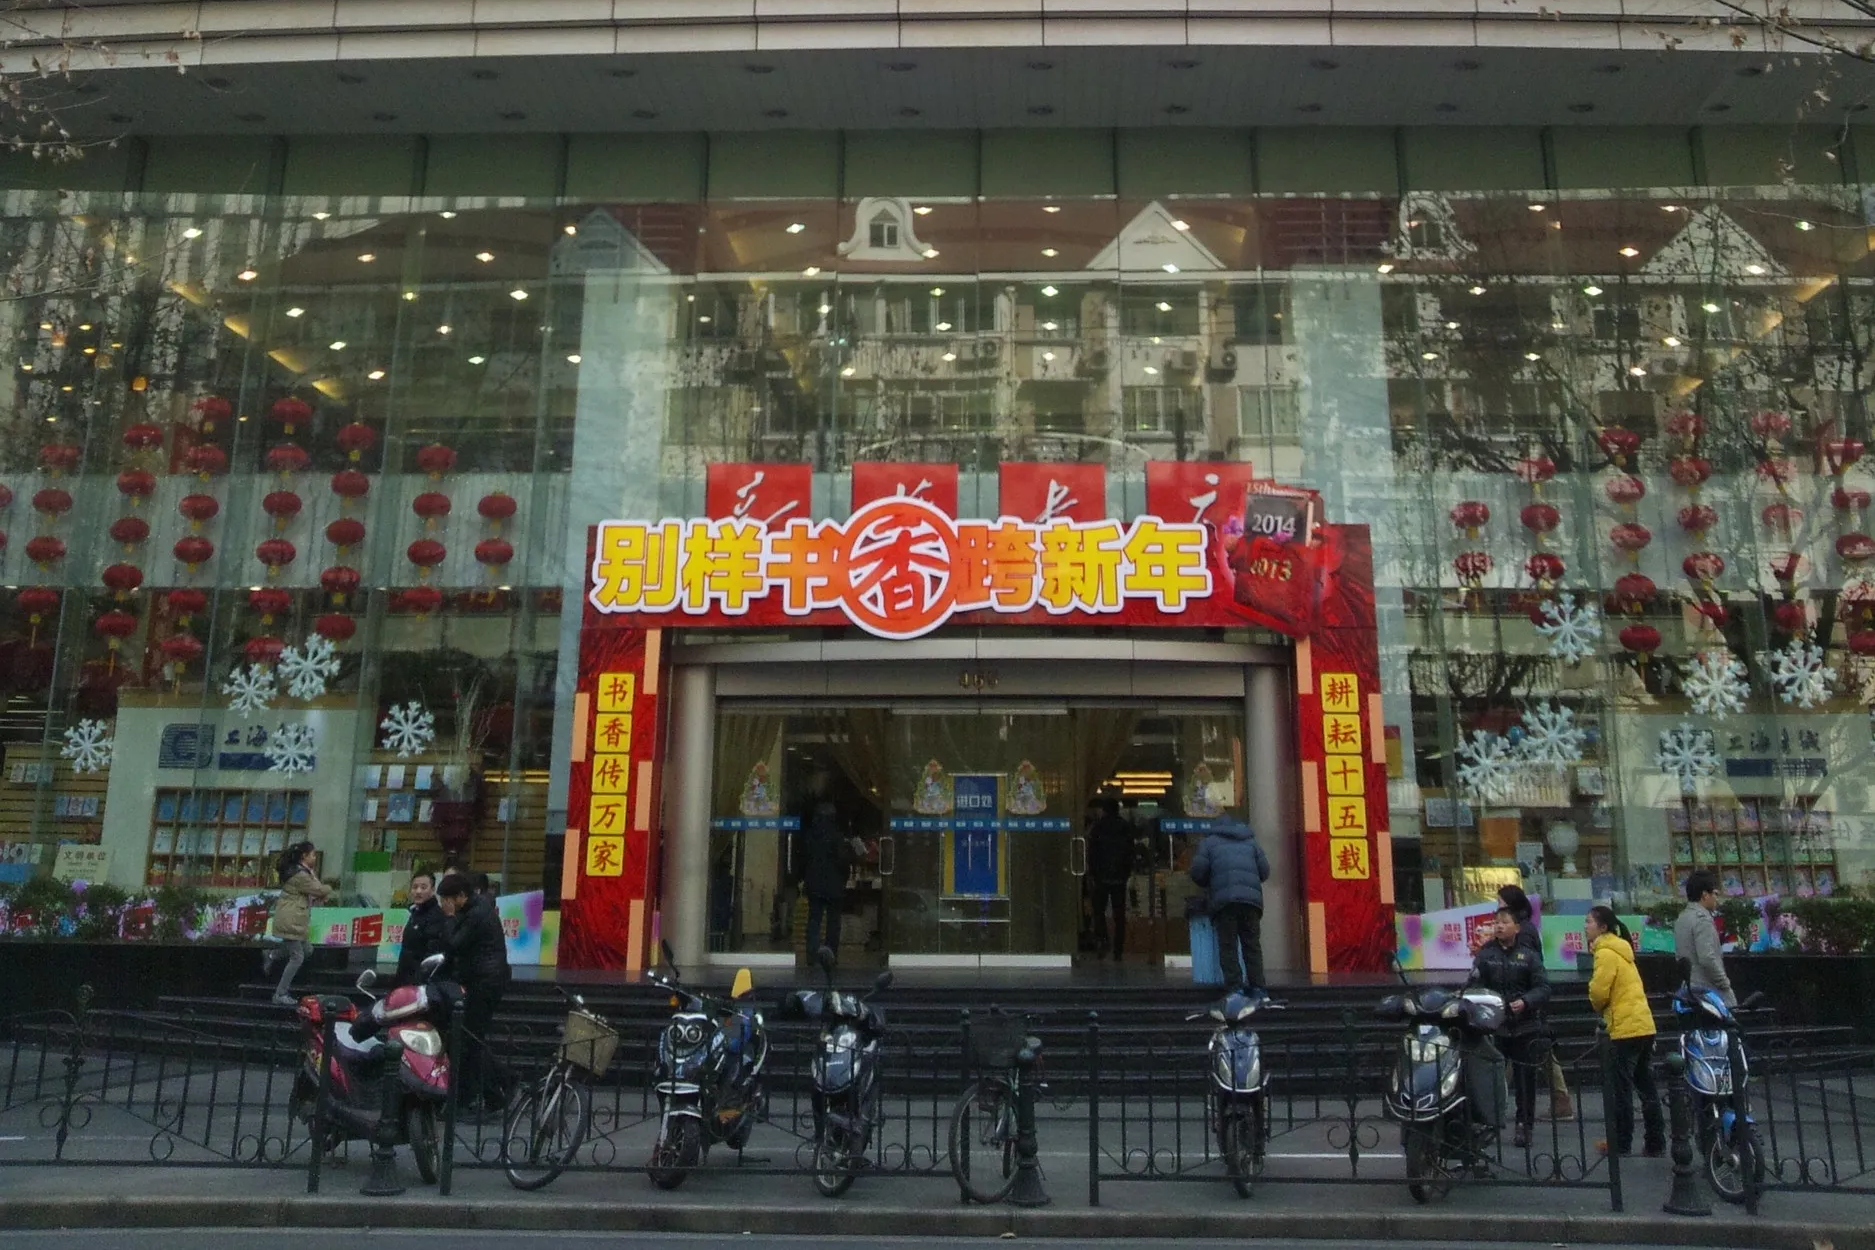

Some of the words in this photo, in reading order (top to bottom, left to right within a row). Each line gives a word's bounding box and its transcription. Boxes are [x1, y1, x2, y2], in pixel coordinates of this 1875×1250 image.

[592, 507, 1212, 628] 别样书香跨新年
[1251, 513, 1296, 536] 2014
[590, 676, 630, 873] 书香传万家
[1324, 676, 1367, 877] 耕耘十五载
